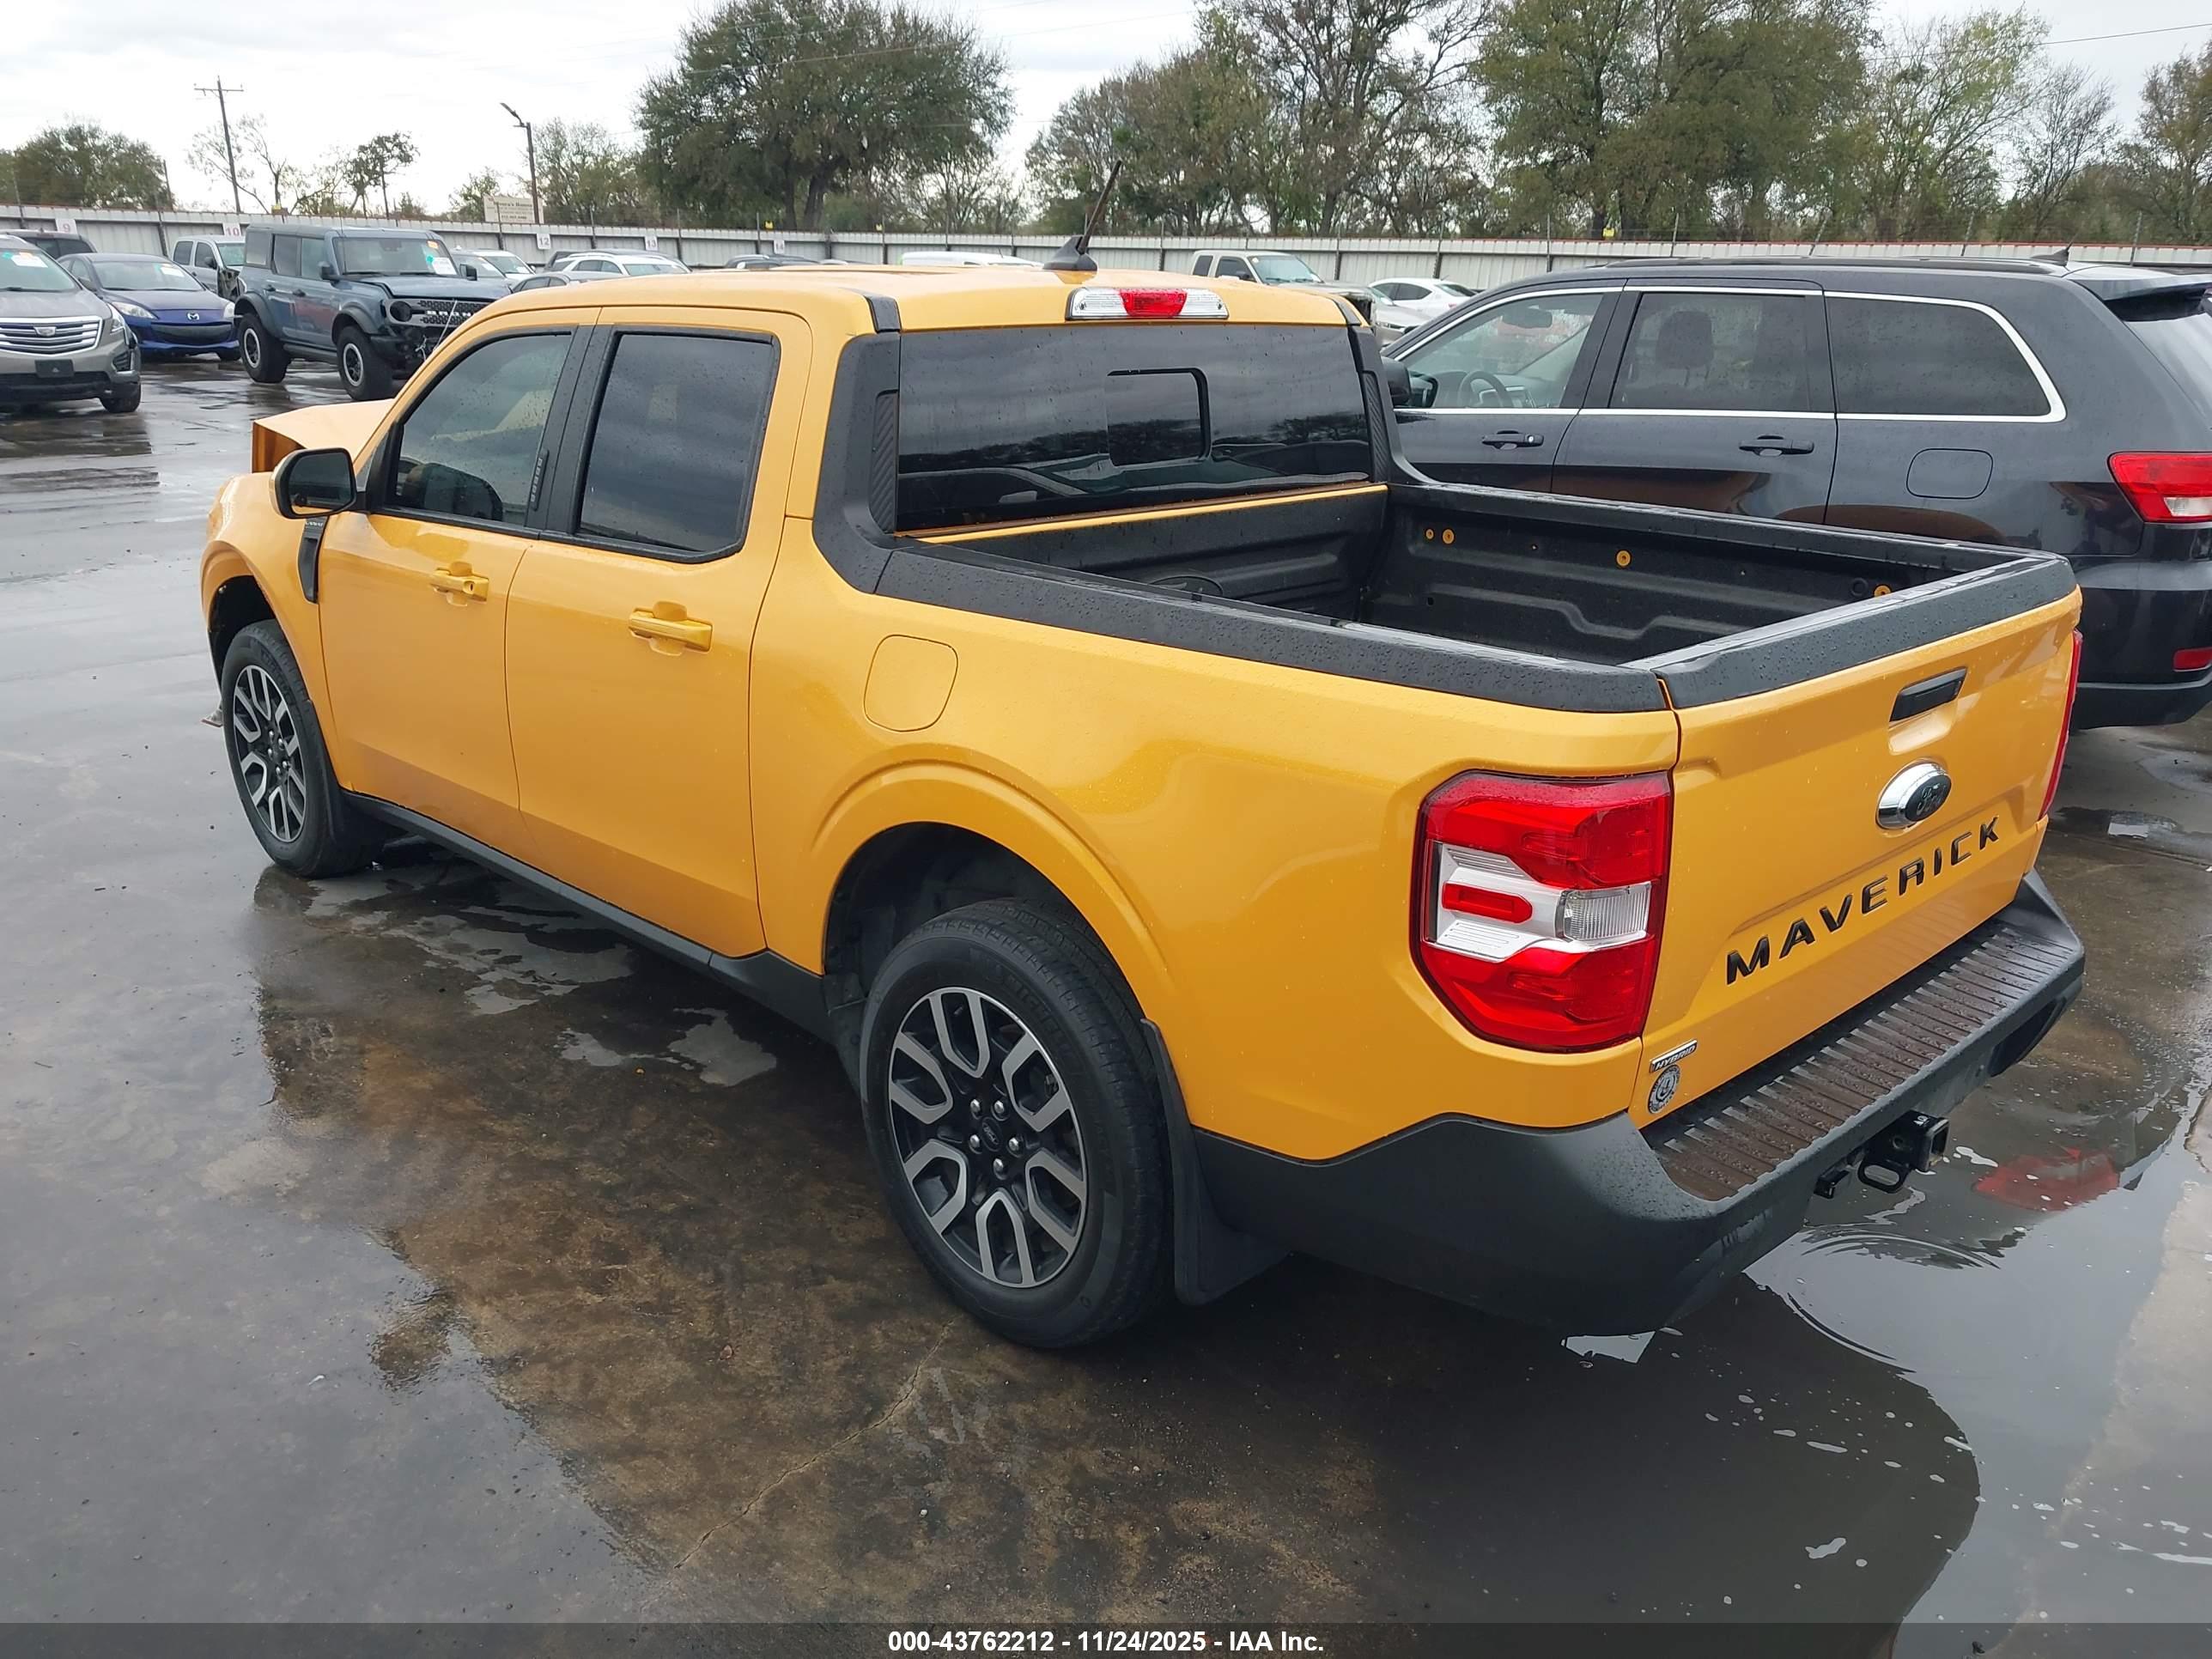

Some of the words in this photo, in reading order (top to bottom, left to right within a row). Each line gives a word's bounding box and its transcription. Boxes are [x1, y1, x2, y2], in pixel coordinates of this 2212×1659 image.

[226, 227, 240, 236] 10
[647, 240, 657, 248] 13
[1726, 815, 2000, 987] MAVERICK
[1655, 1044, 1697, 1071] HYBRID
